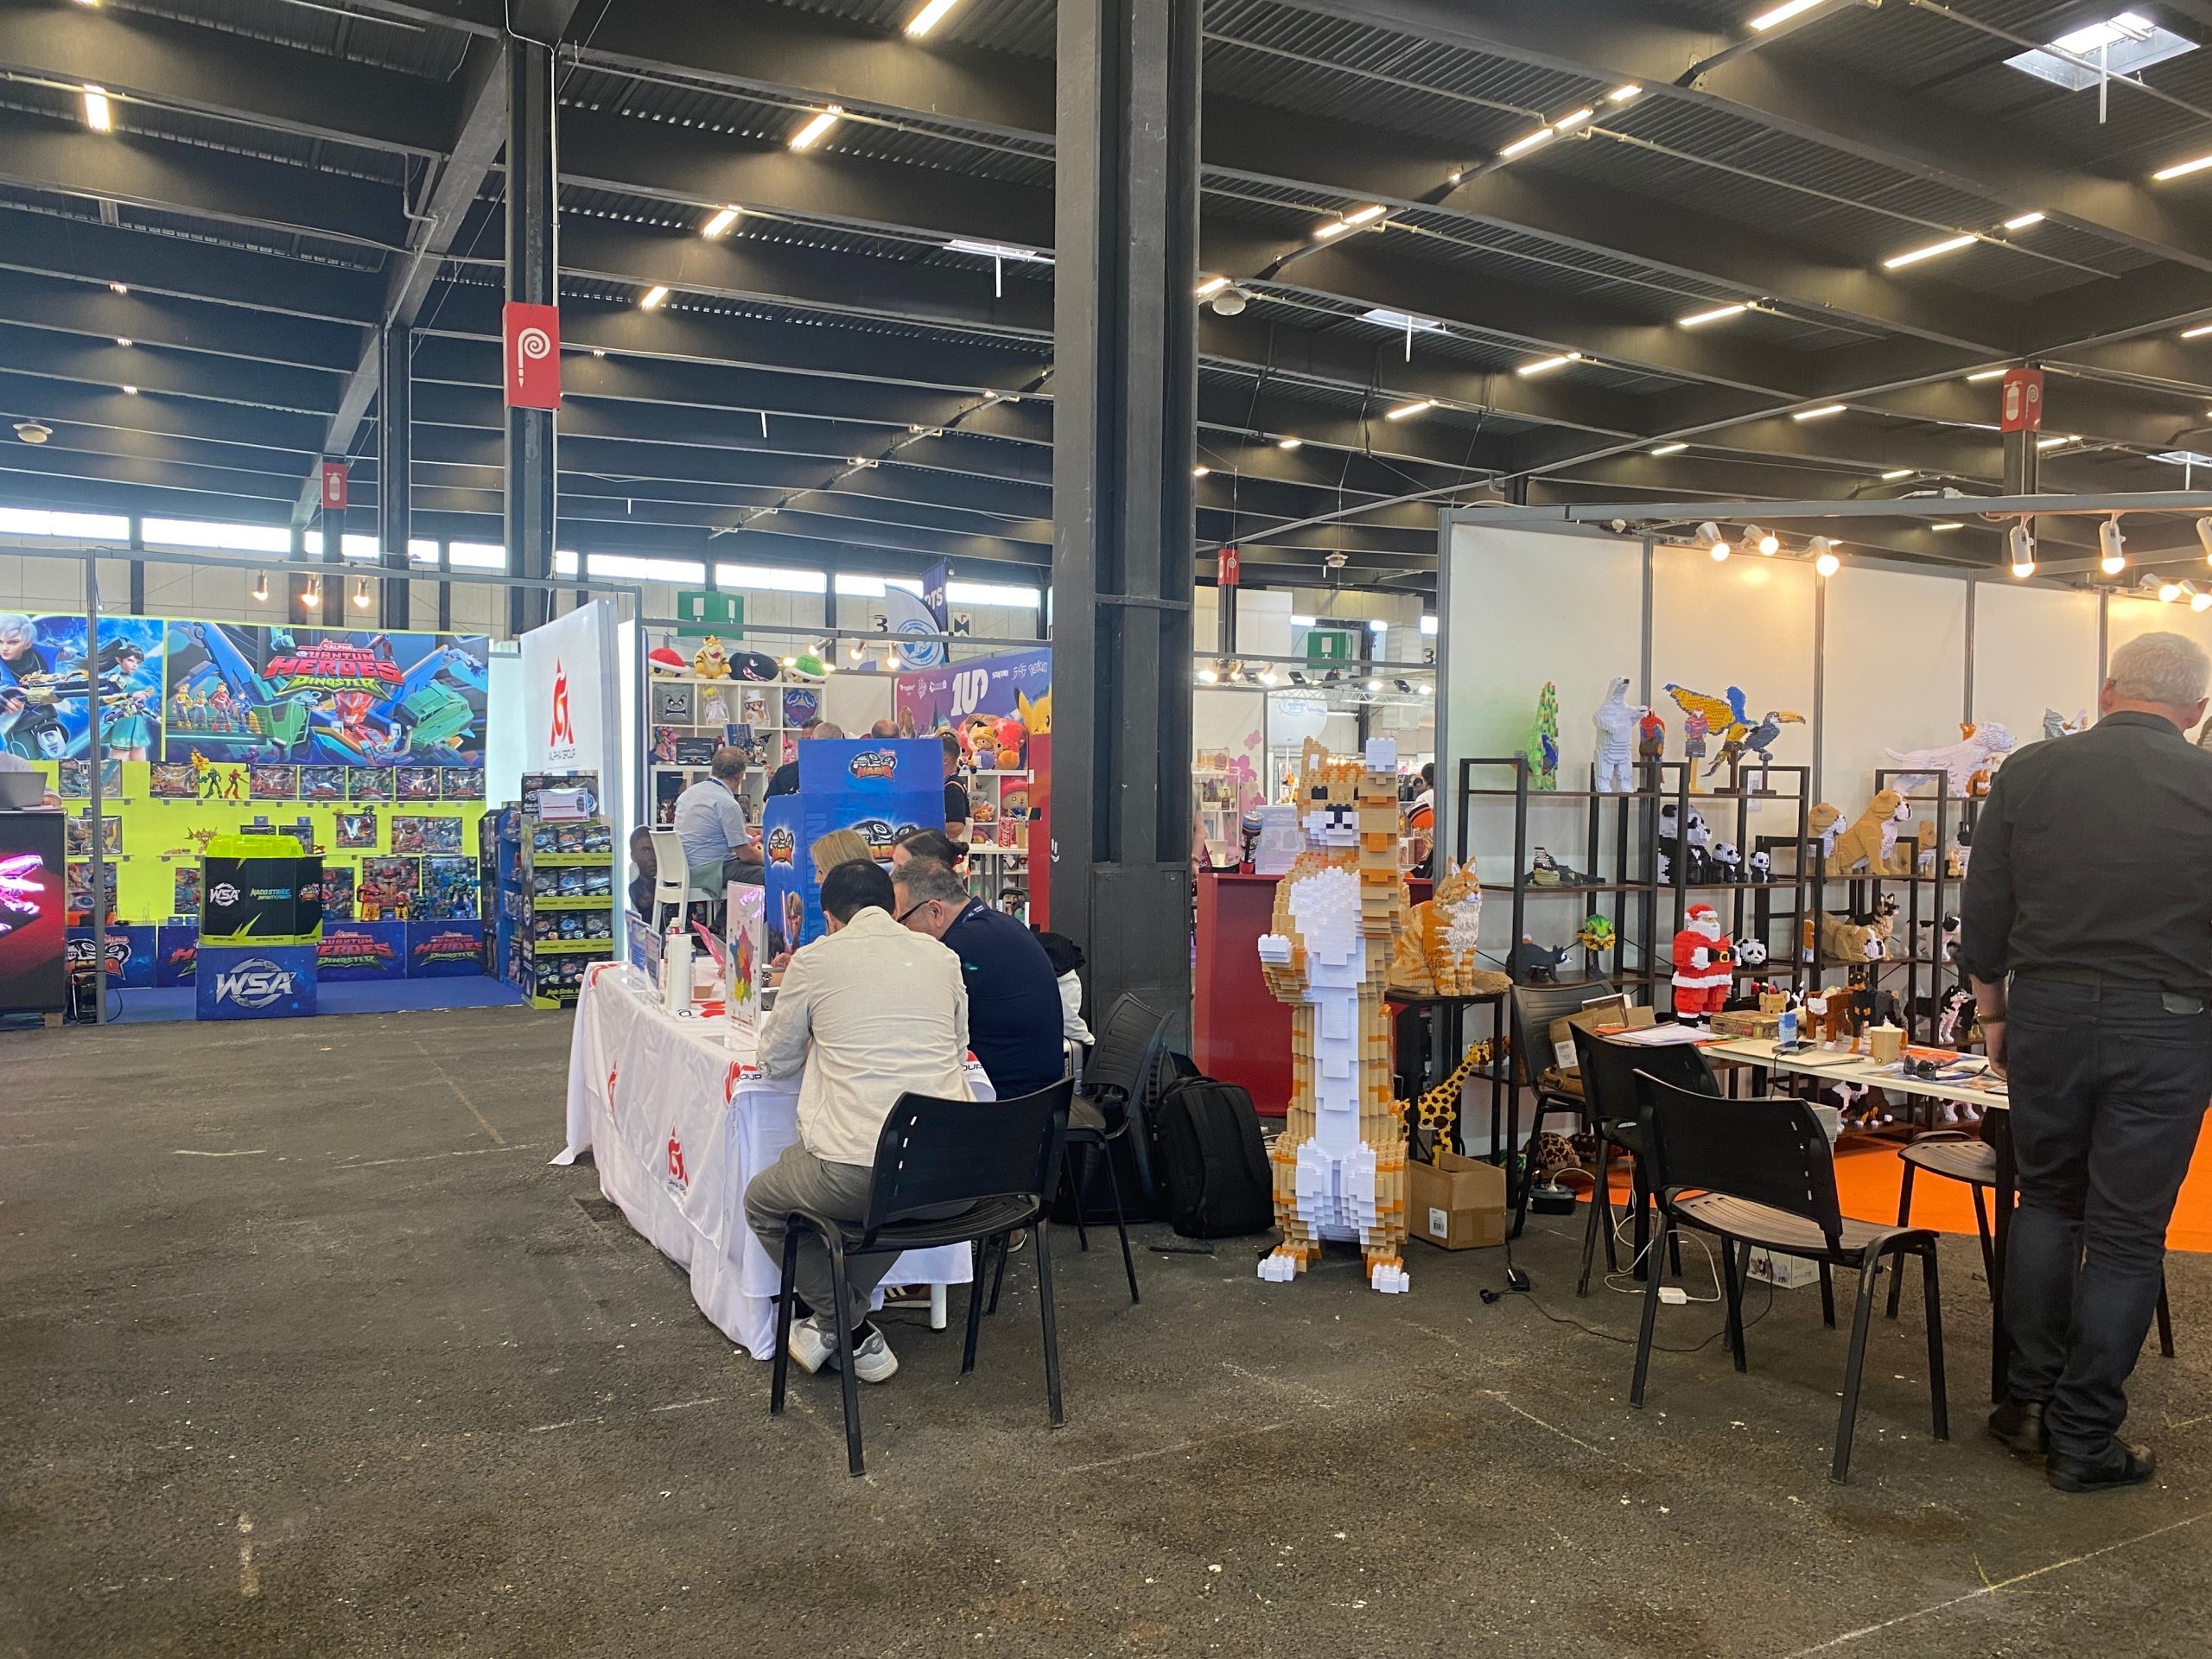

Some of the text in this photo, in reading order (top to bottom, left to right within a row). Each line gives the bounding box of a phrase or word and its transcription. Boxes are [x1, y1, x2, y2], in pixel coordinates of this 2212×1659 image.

[296, 650, 375, 661] QUANTUM
[263, 656, 405, 685] HEROES
[209, 887, 241, 904] WSA
[317, 944, 395, 959] EROES
[215, 971, 297, 1004] WSA
